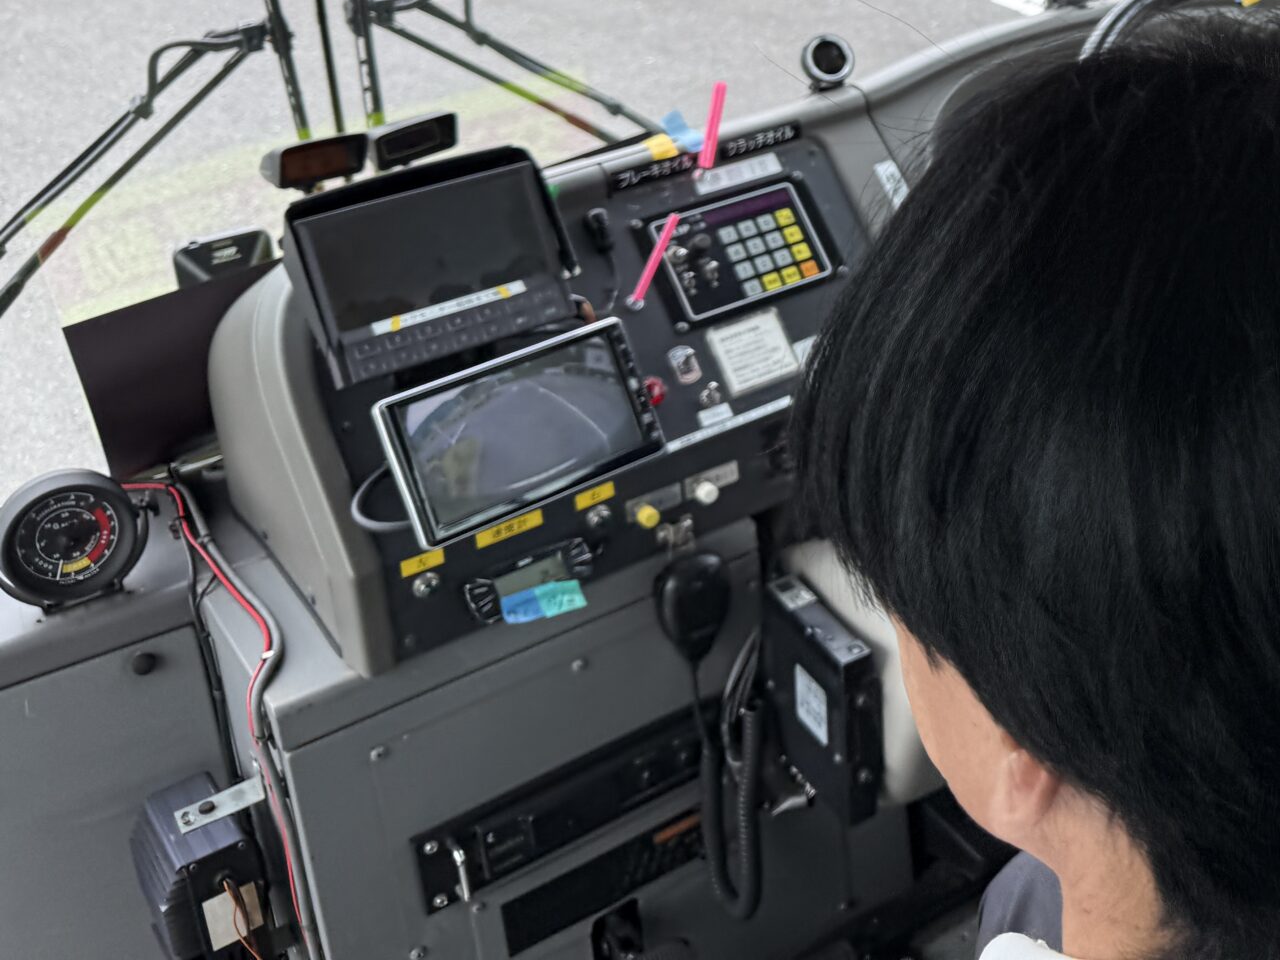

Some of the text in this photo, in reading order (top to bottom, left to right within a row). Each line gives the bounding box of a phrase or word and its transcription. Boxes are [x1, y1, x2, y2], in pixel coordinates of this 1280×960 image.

[727, 125, 795, 157] クラッチオイル
[618, 153, 694, 189] ブレーキオイル
